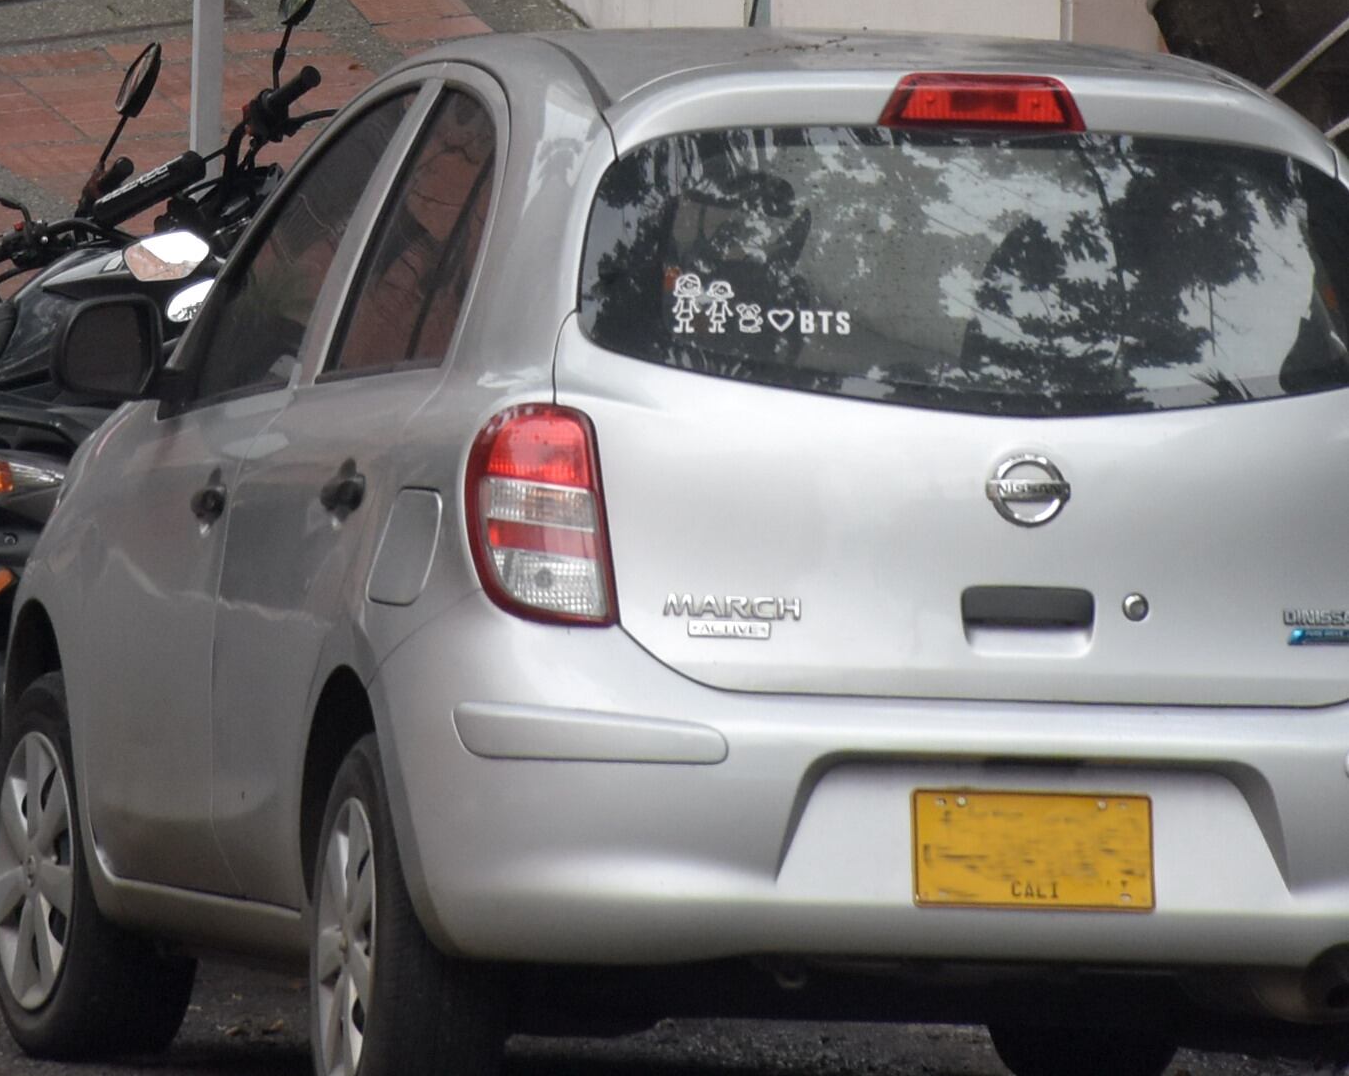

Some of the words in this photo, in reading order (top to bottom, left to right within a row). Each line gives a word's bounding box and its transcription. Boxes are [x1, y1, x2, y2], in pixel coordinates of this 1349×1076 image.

[800, 310, 851, 335] BTS
[663, 593, 801, 621] MARCH
[700, 622, 759, 635] ACTIVE
[1011, 880, 1059, 898] CALI
